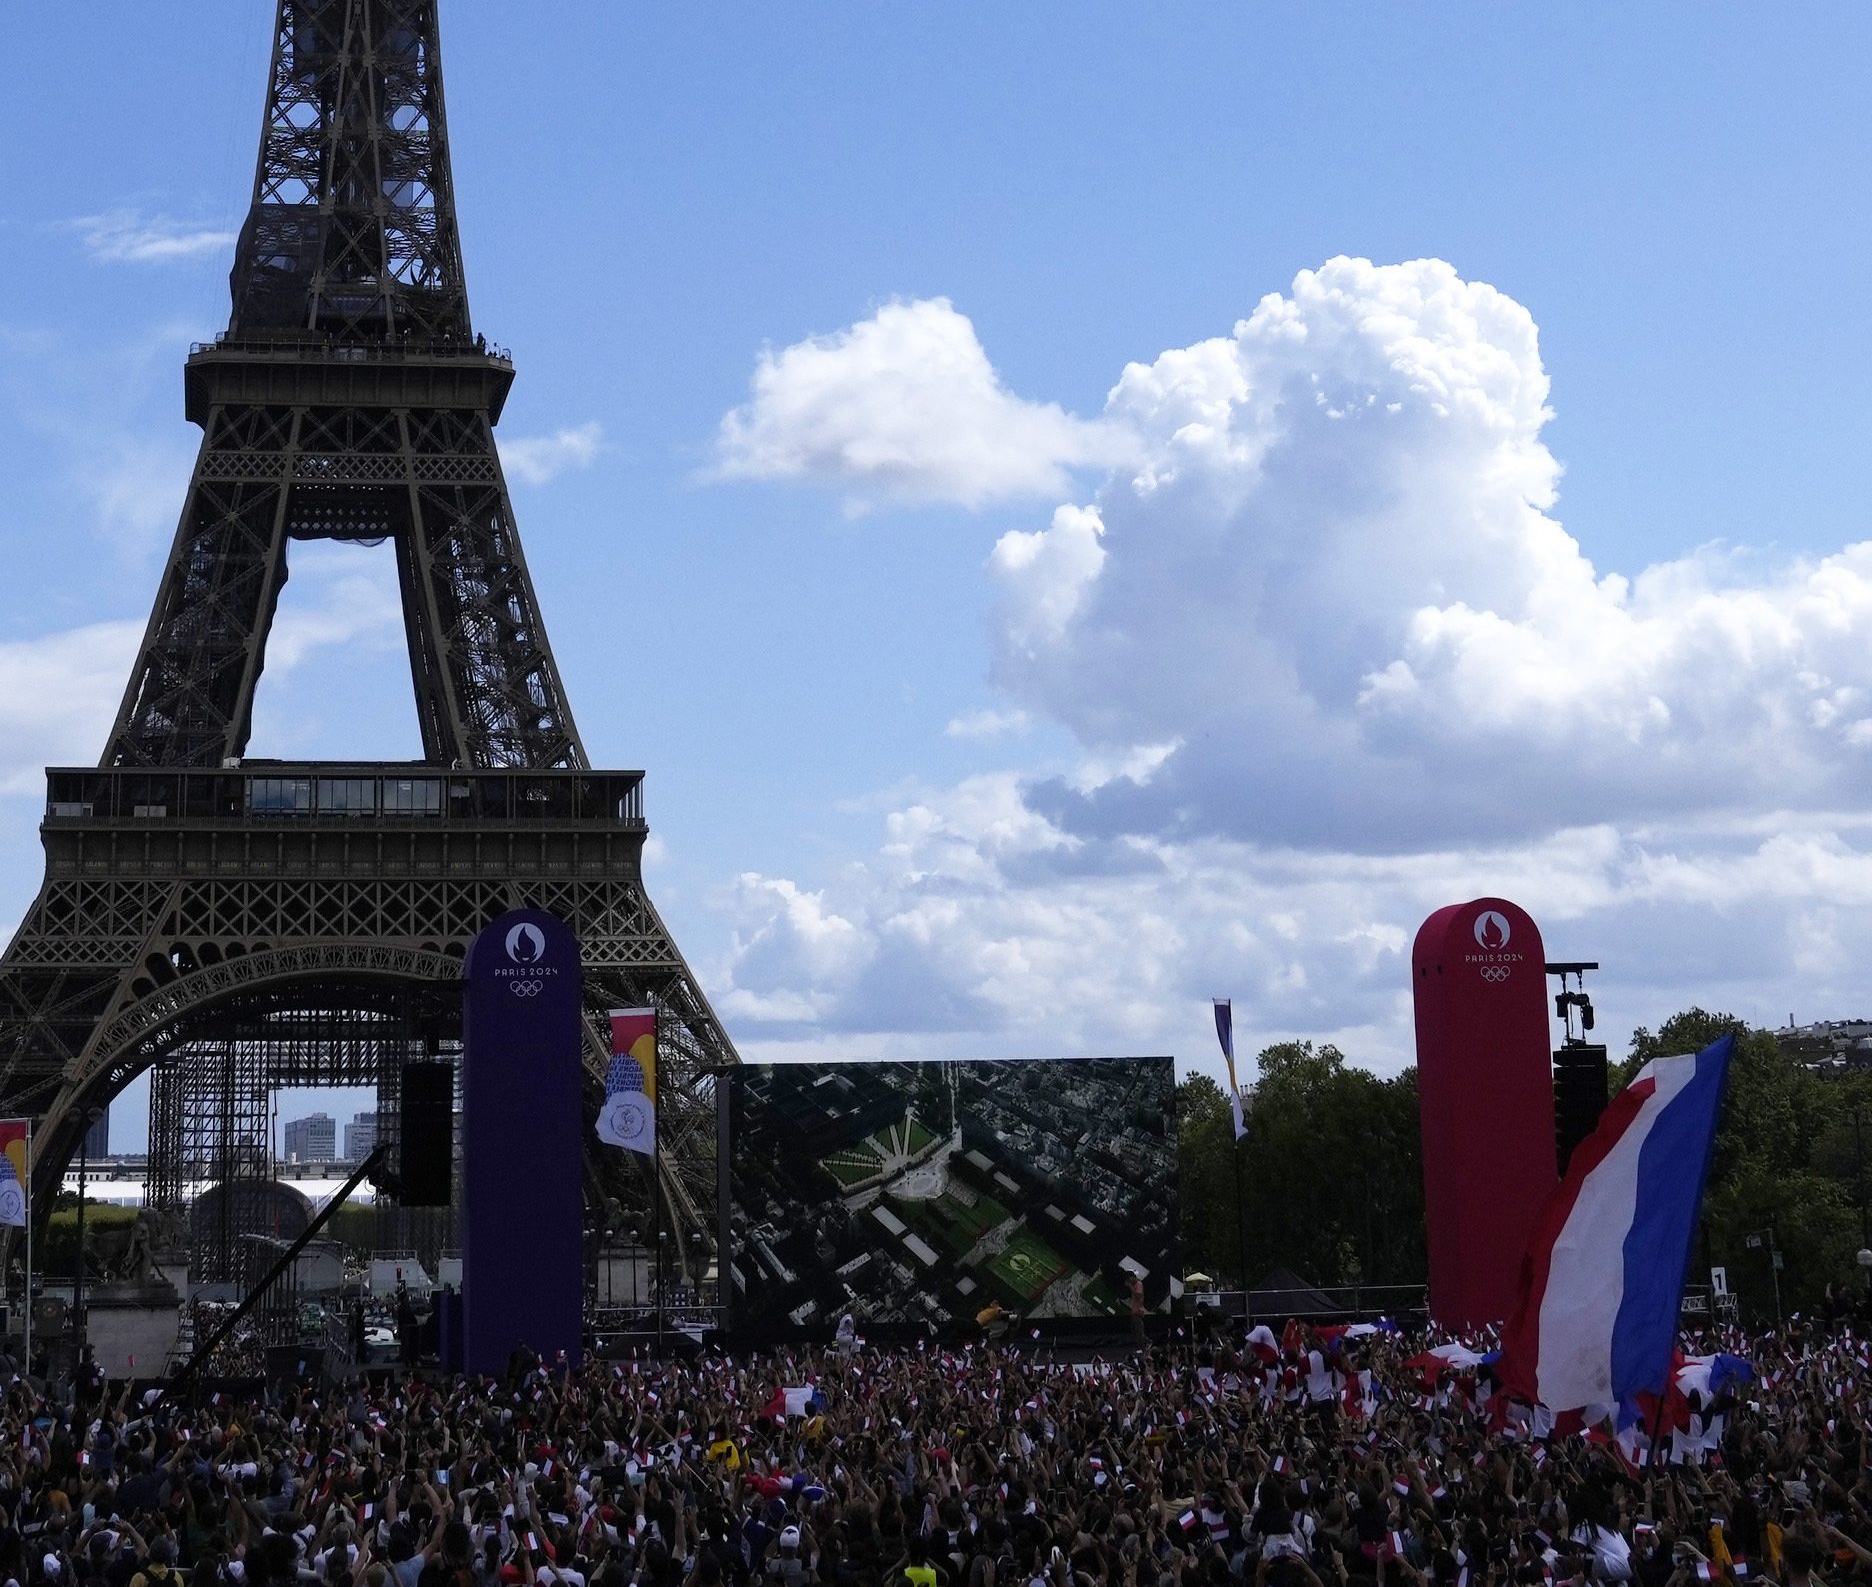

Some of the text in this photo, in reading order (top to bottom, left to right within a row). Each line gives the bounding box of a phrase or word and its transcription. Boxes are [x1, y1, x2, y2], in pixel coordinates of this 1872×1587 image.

[1466, 954, 1523, 962] PARIS 2024
[494, 967, 558, 977] PARIS 2024
[1715, 1274, 1722, 1290] 1
